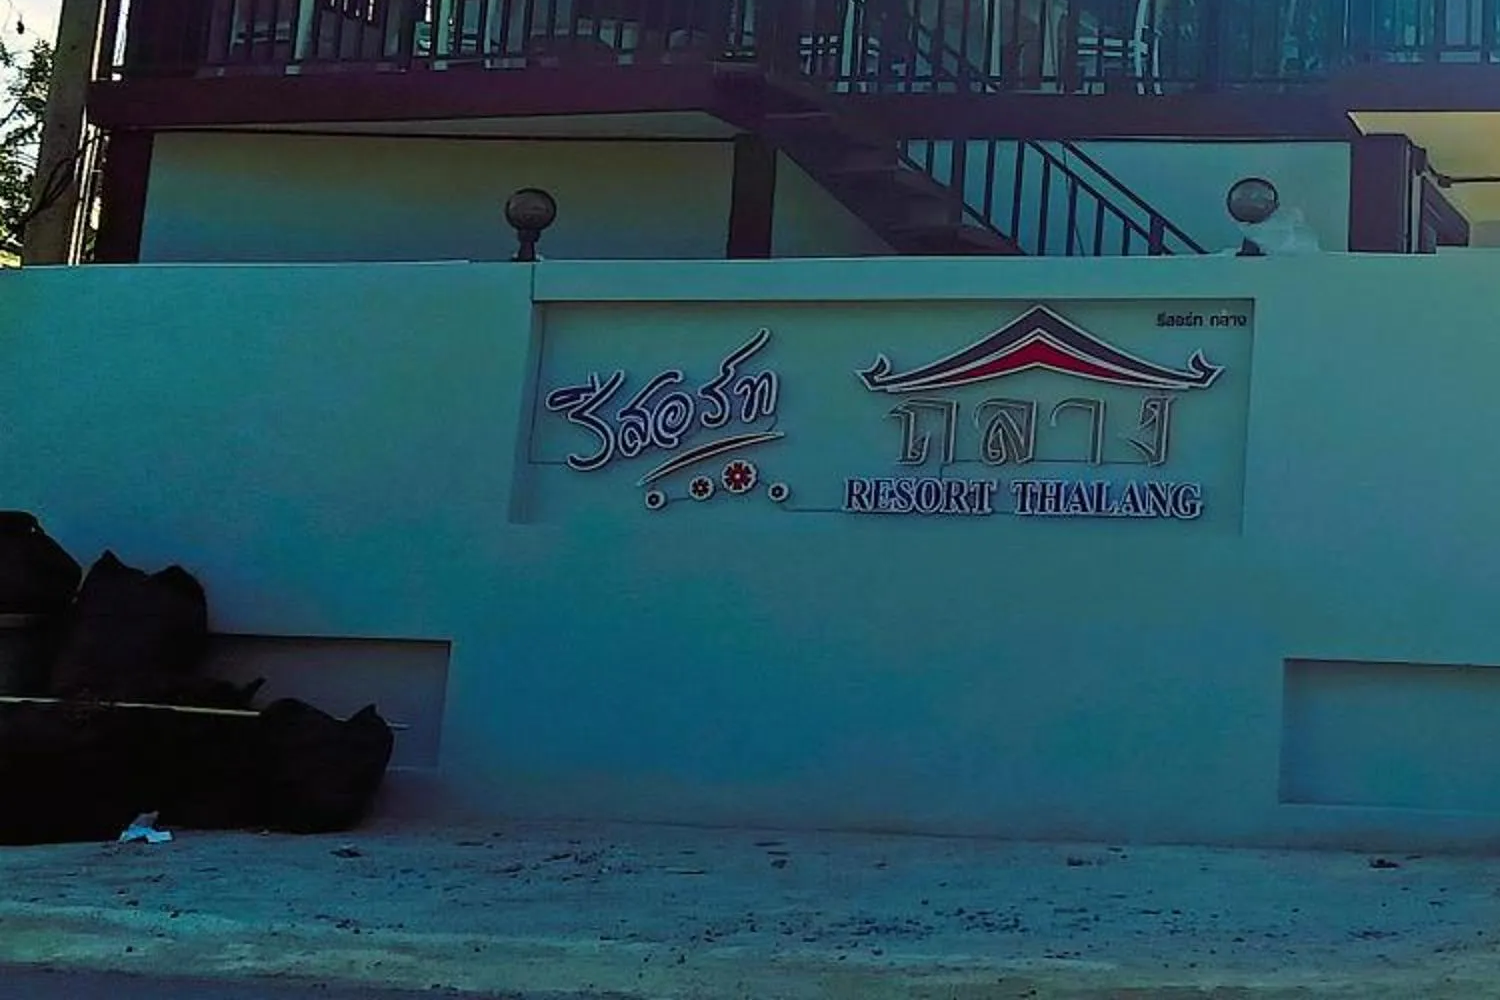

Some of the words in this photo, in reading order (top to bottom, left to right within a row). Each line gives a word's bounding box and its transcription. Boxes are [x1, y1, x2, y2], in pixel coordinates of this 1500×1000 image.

[545, 327, 779, 471] รีสอร์ท
[883, 395, 1176, 465] ถลาง
[845, 476, 996, 516] RESORT
[1012, 478, 1203, 519] THALANG
